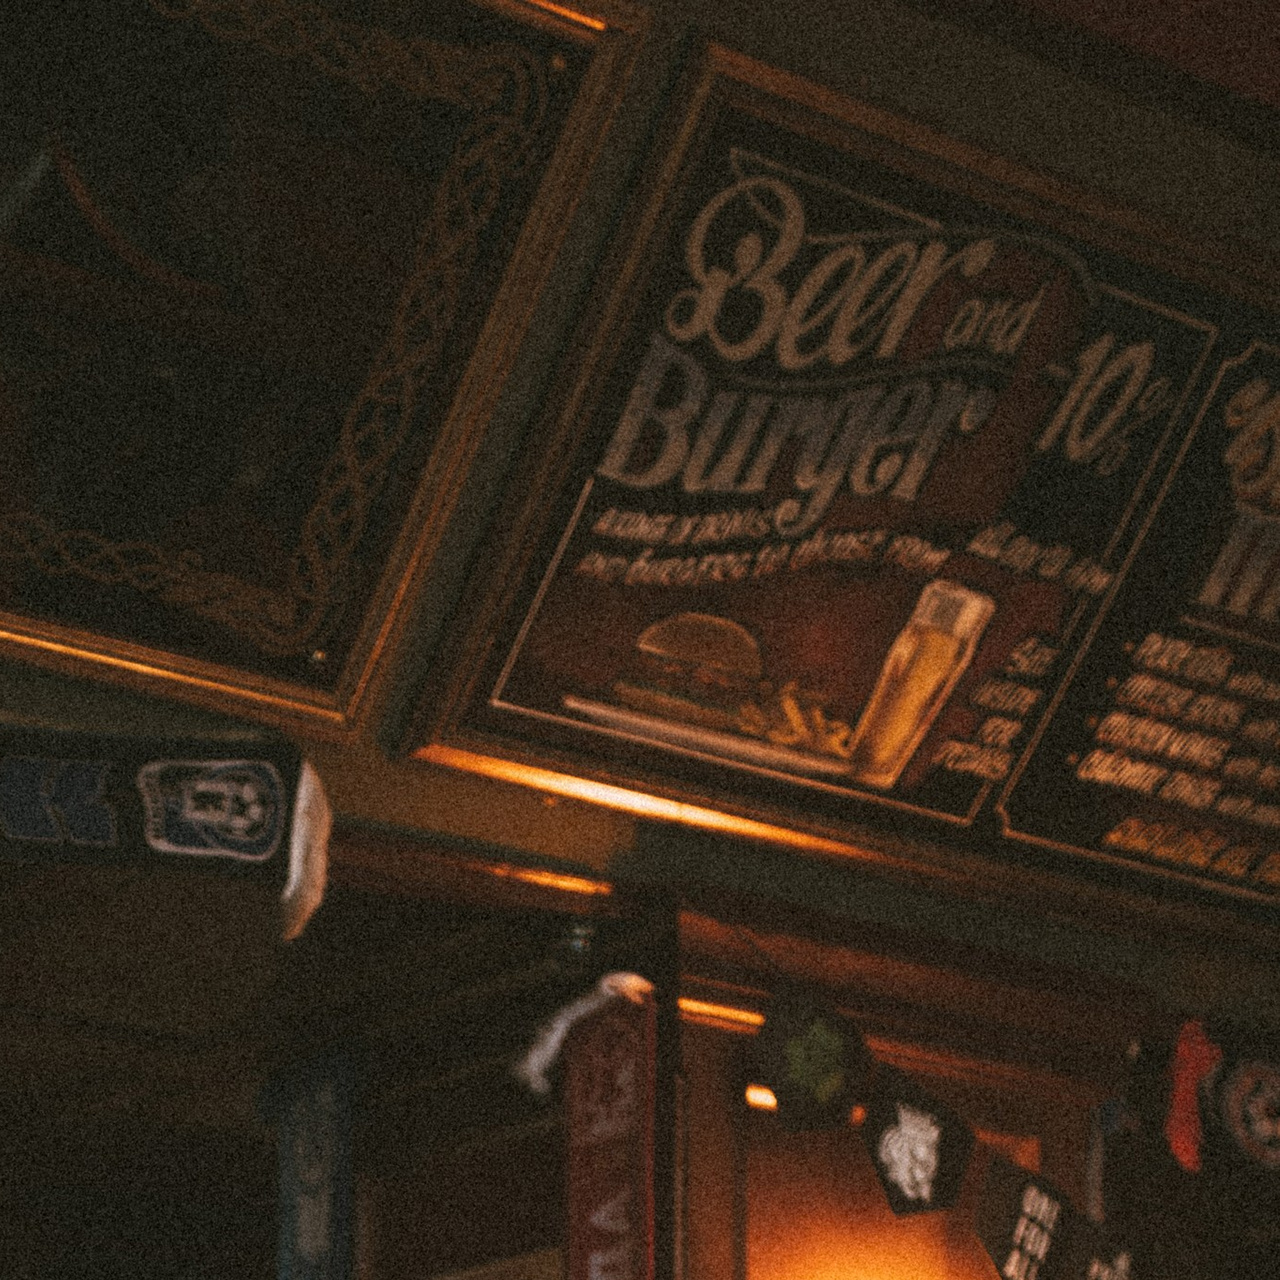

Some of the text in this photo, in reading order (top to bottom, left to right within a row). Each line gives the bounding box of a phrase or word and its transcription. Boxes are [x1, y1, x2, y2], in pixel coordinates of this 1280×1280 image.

[665, 175, 1046, 370] Beer and
[596, 330, 994, 535] Burger
